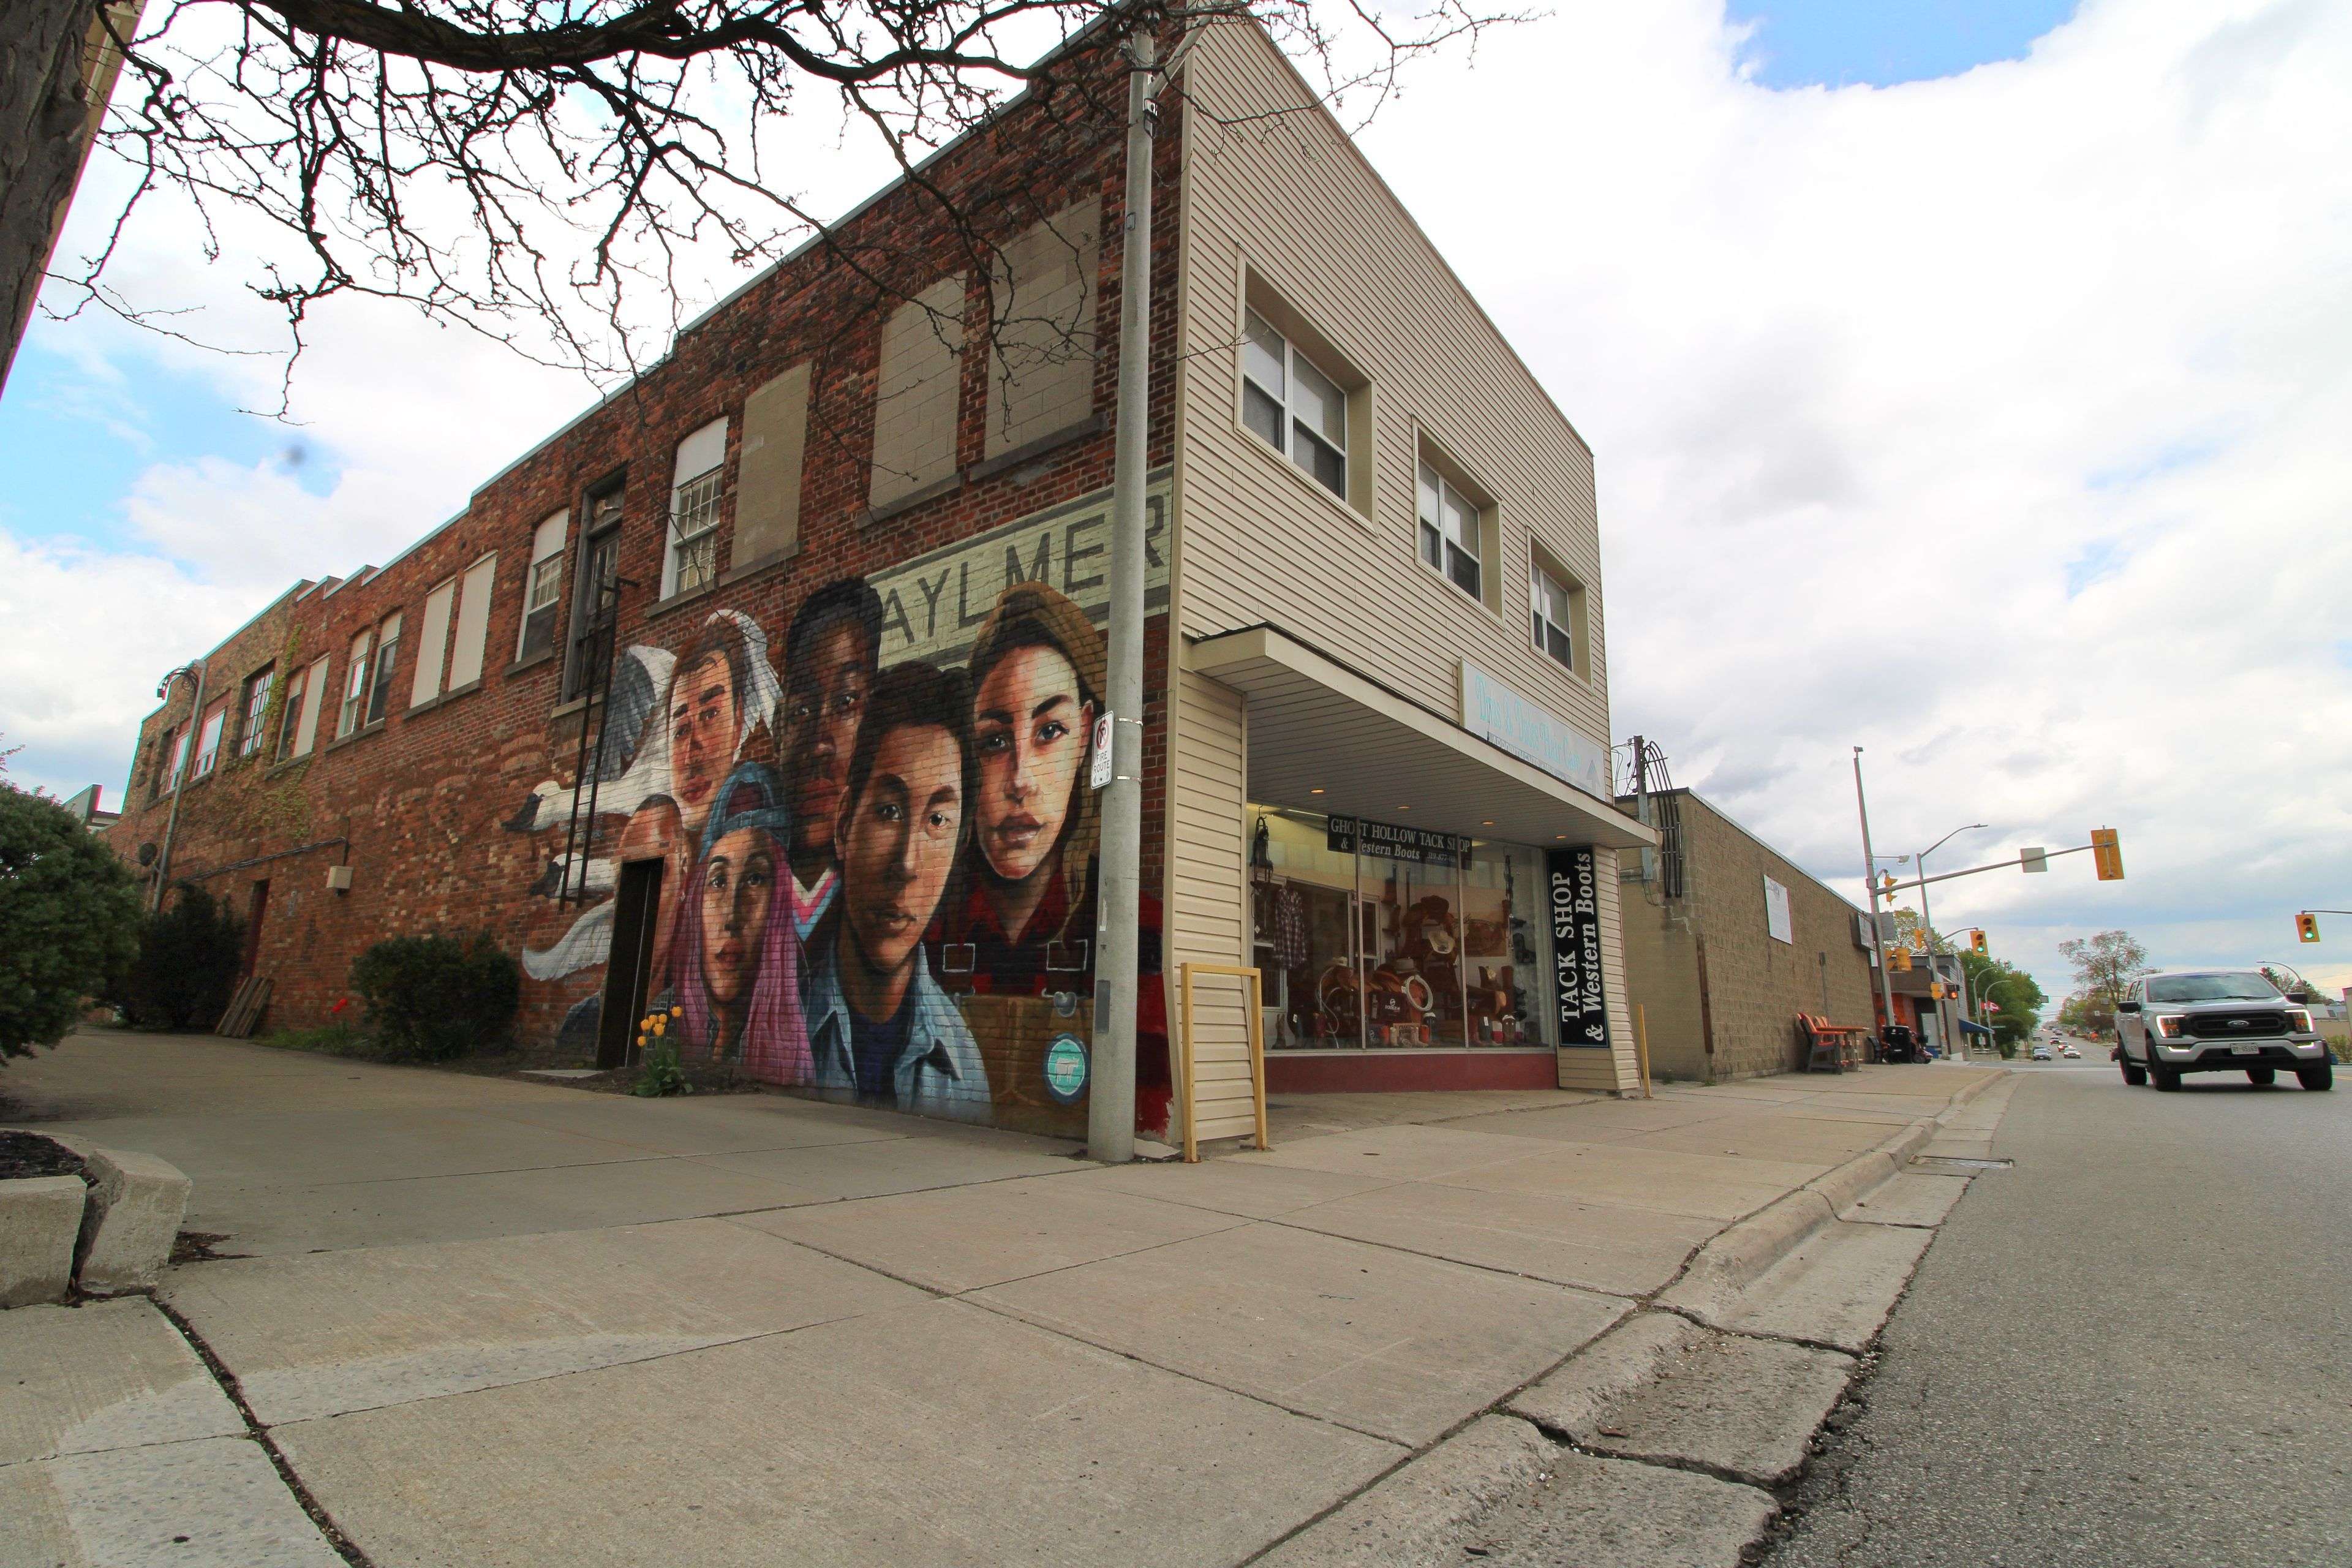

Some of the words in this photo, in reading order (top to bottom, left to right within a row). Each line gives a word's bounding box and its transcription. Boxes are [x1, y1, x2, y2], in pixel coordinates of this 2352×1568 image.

[881, 494, 1164, 644] AYLMER
[1093, 760, 1110, 774] ROUTE
[1096, 751, 1107, 763] FIRE
[1341, 837, 1348, 850] &
[1394, 844, 1420, 860] Boots
[1372, 824, 1417, 843] HOLLOW
[1419, 832, 1444, 849] TACK
[1552, 872, 1574, 938] SHOP
[1575, 853, 1594, 915] Boots
[1558, 951, 1580, 1022] TACK
[1581, 923, 1602, 1013] Western
[1585, 1023, 1604, 1041] &
